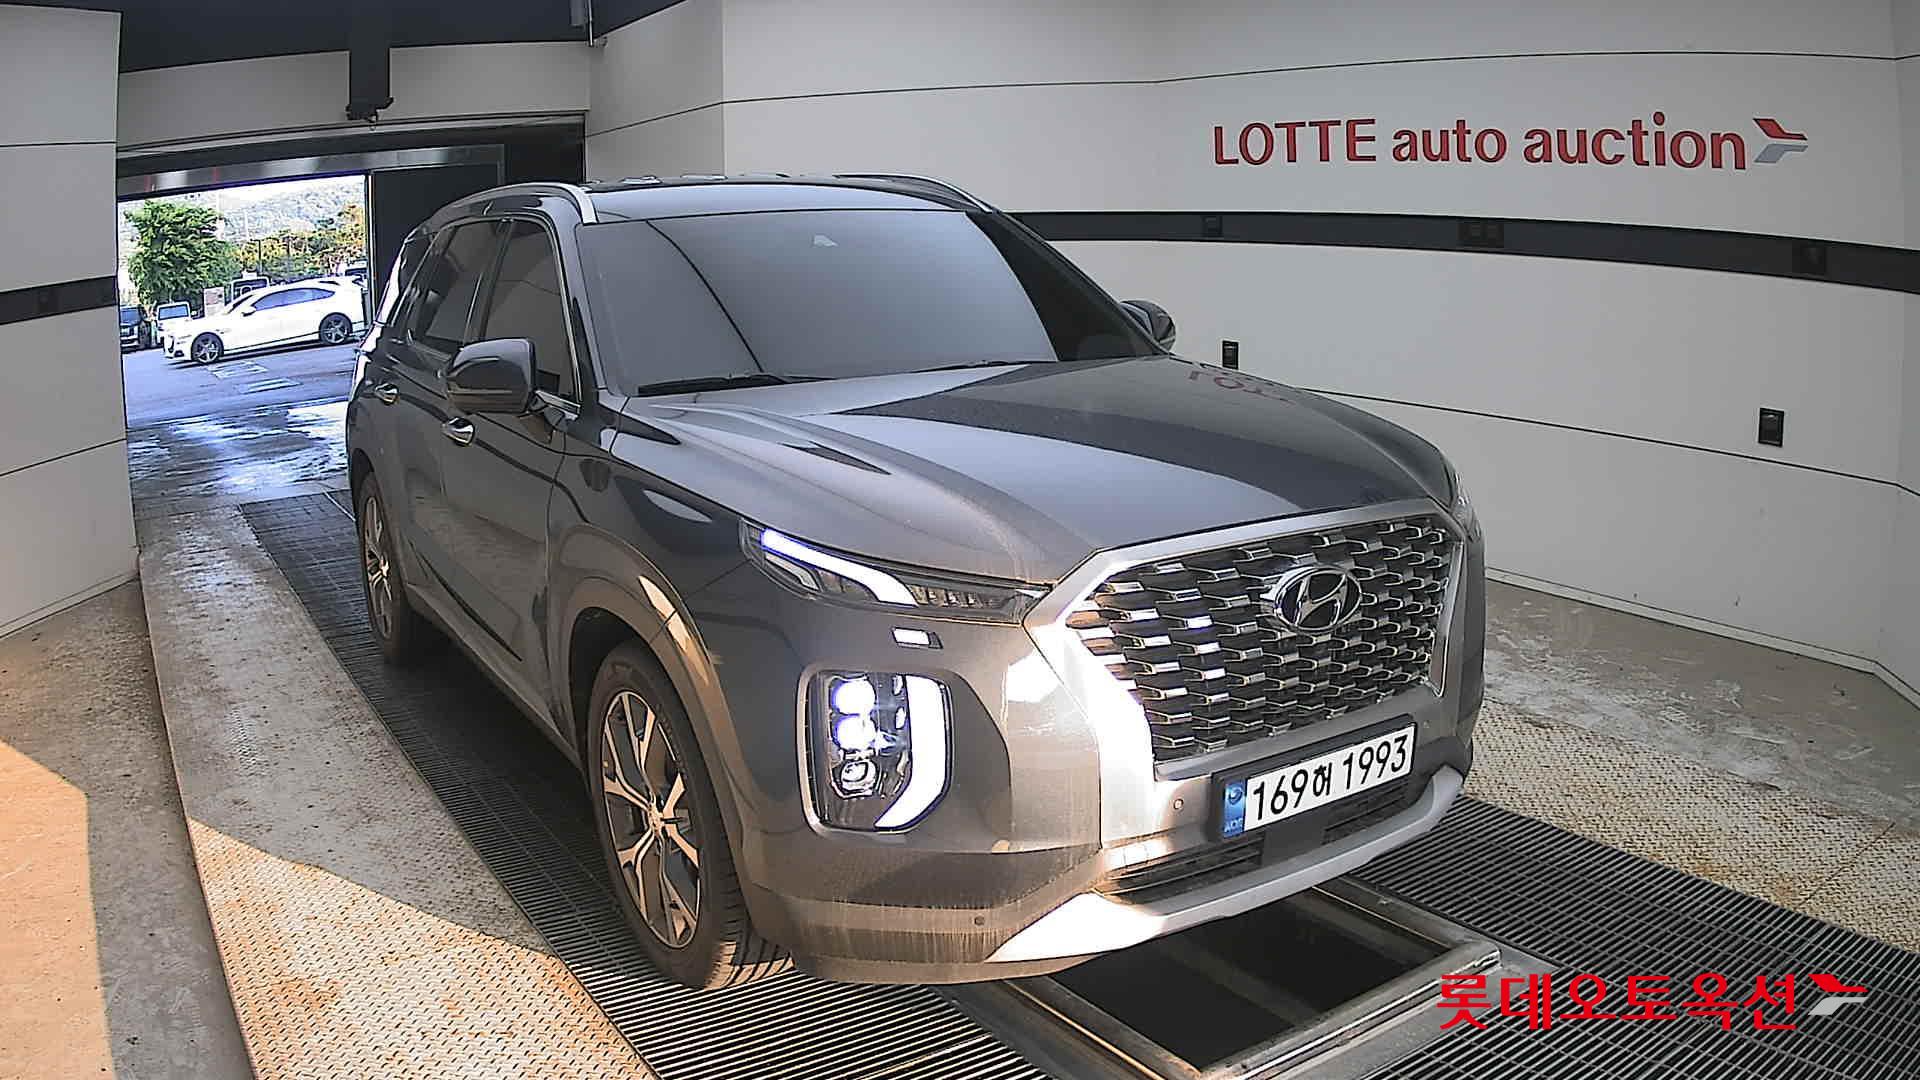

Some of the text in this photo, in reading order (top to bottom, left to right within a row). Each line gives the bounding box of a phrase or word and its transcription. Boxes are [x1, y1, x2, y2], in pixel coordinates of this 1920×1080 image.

[1213, 112, 1747, 170] LOTTE auto auction
[1252, 734, 1409, 821] 169허 1993
